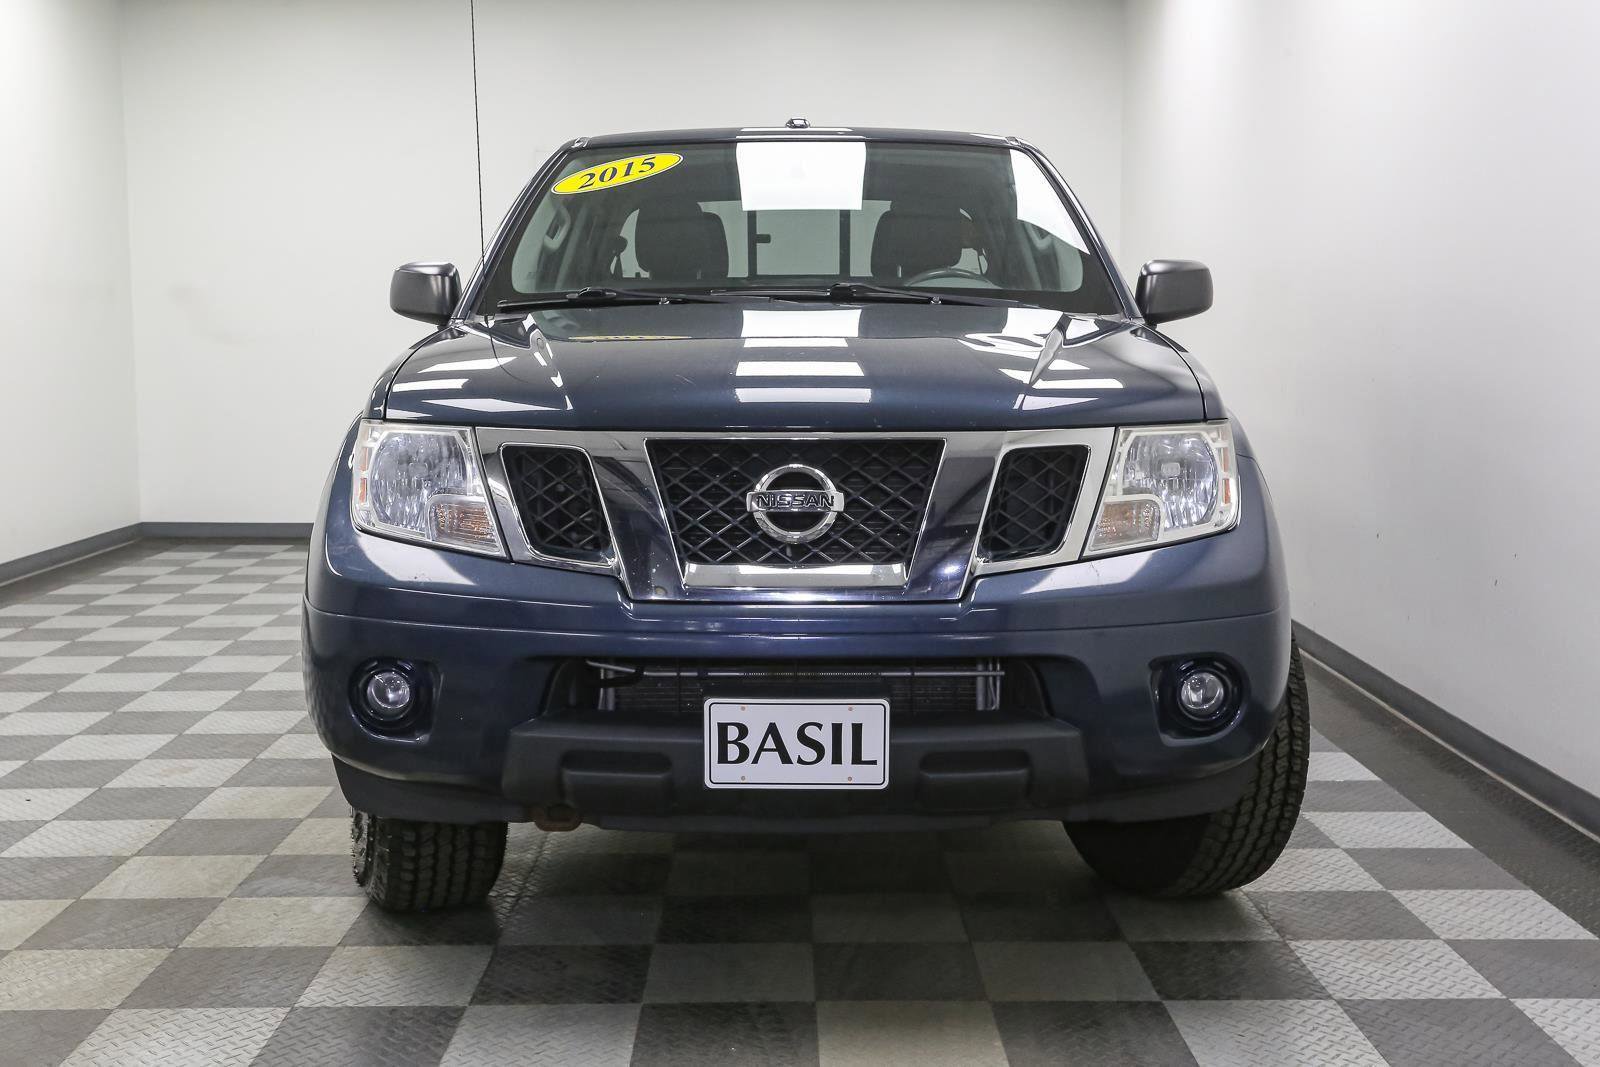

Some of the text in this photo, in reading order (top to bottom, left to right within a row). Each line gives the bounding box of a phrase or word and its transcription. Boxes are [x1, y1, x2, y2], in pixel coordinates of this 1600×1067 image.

[578, 156, 656, 190] 2015
[756, 494, 835, 508] NISSAN
[716, 721, 878, 766] BASIL
